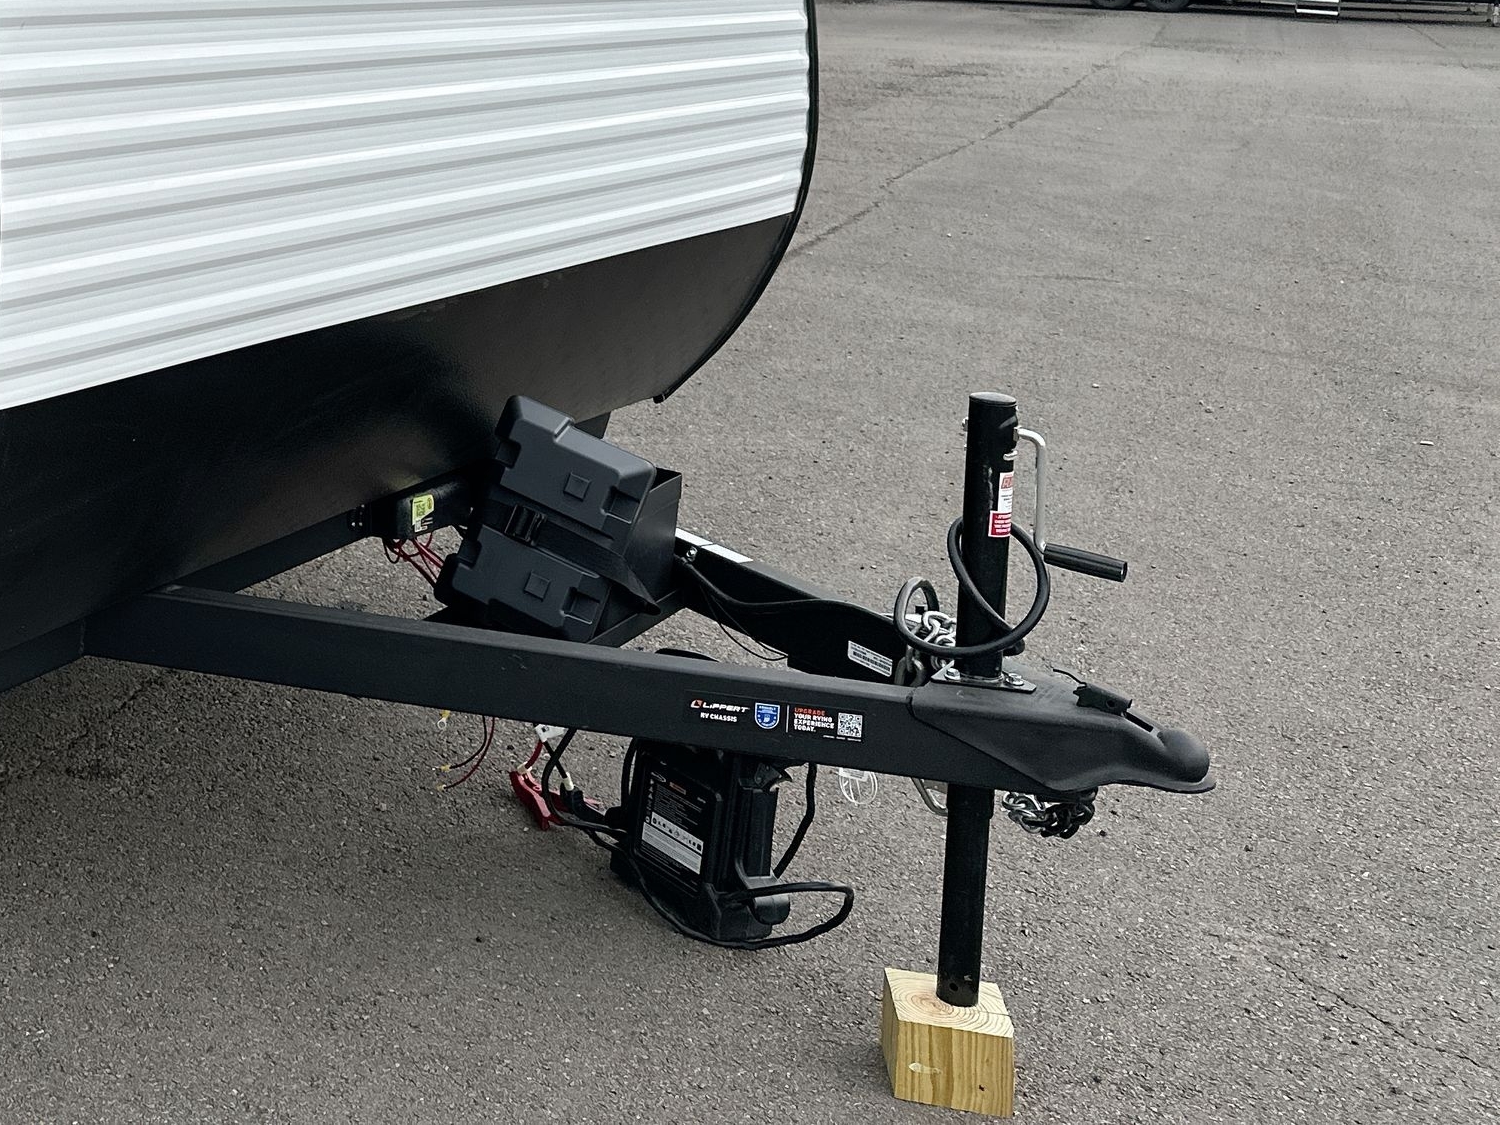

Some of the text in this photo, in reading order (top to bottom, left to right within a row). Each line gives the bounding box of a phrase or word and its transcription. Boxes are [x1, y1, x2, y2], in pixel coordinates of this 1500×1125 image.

[794, 707, 826, 716] UPGRADE
[709, 713, 738, 723] CHASSIS
[793, 713, 812, 721] YOUR
[793, 718, 835, 729] EXPERIENCE
